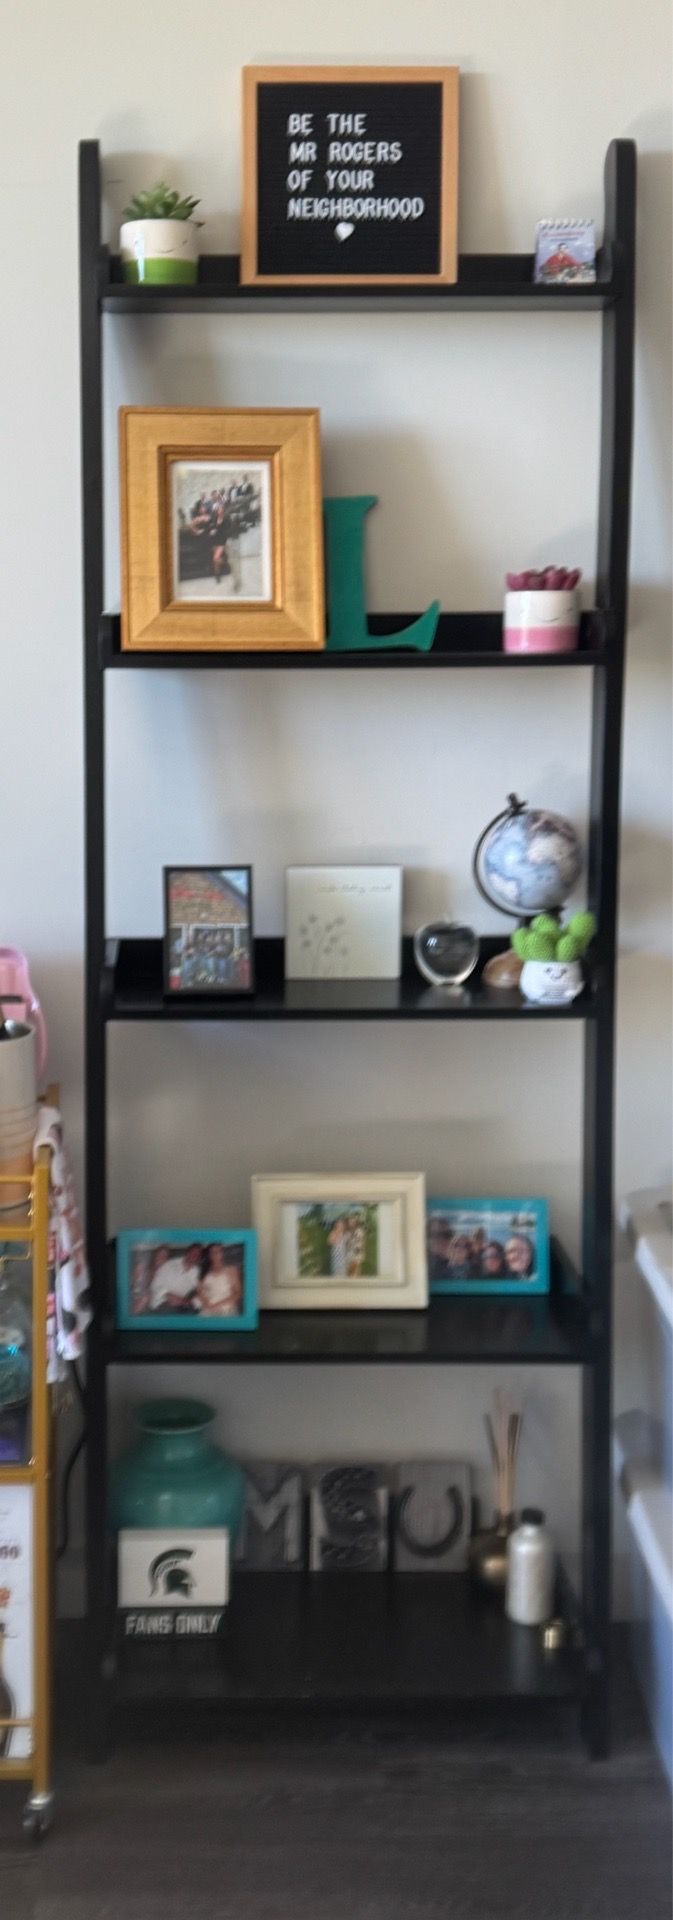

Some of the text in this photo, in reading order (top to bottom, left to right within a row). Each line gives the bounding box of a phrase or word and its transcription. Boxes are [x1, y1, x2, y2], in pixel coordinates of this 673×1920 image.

[287, 113, 367, 135] BE THE
[289, 141, 403, 163] MR ROGERS
[287, 169, 375, 191] OF YOUR
[287, 197, 425, 220] NEIGHBORHOOD
[322, 495, 441, 652] L
[125, 1613, 221, 1634] FANS ONLY
